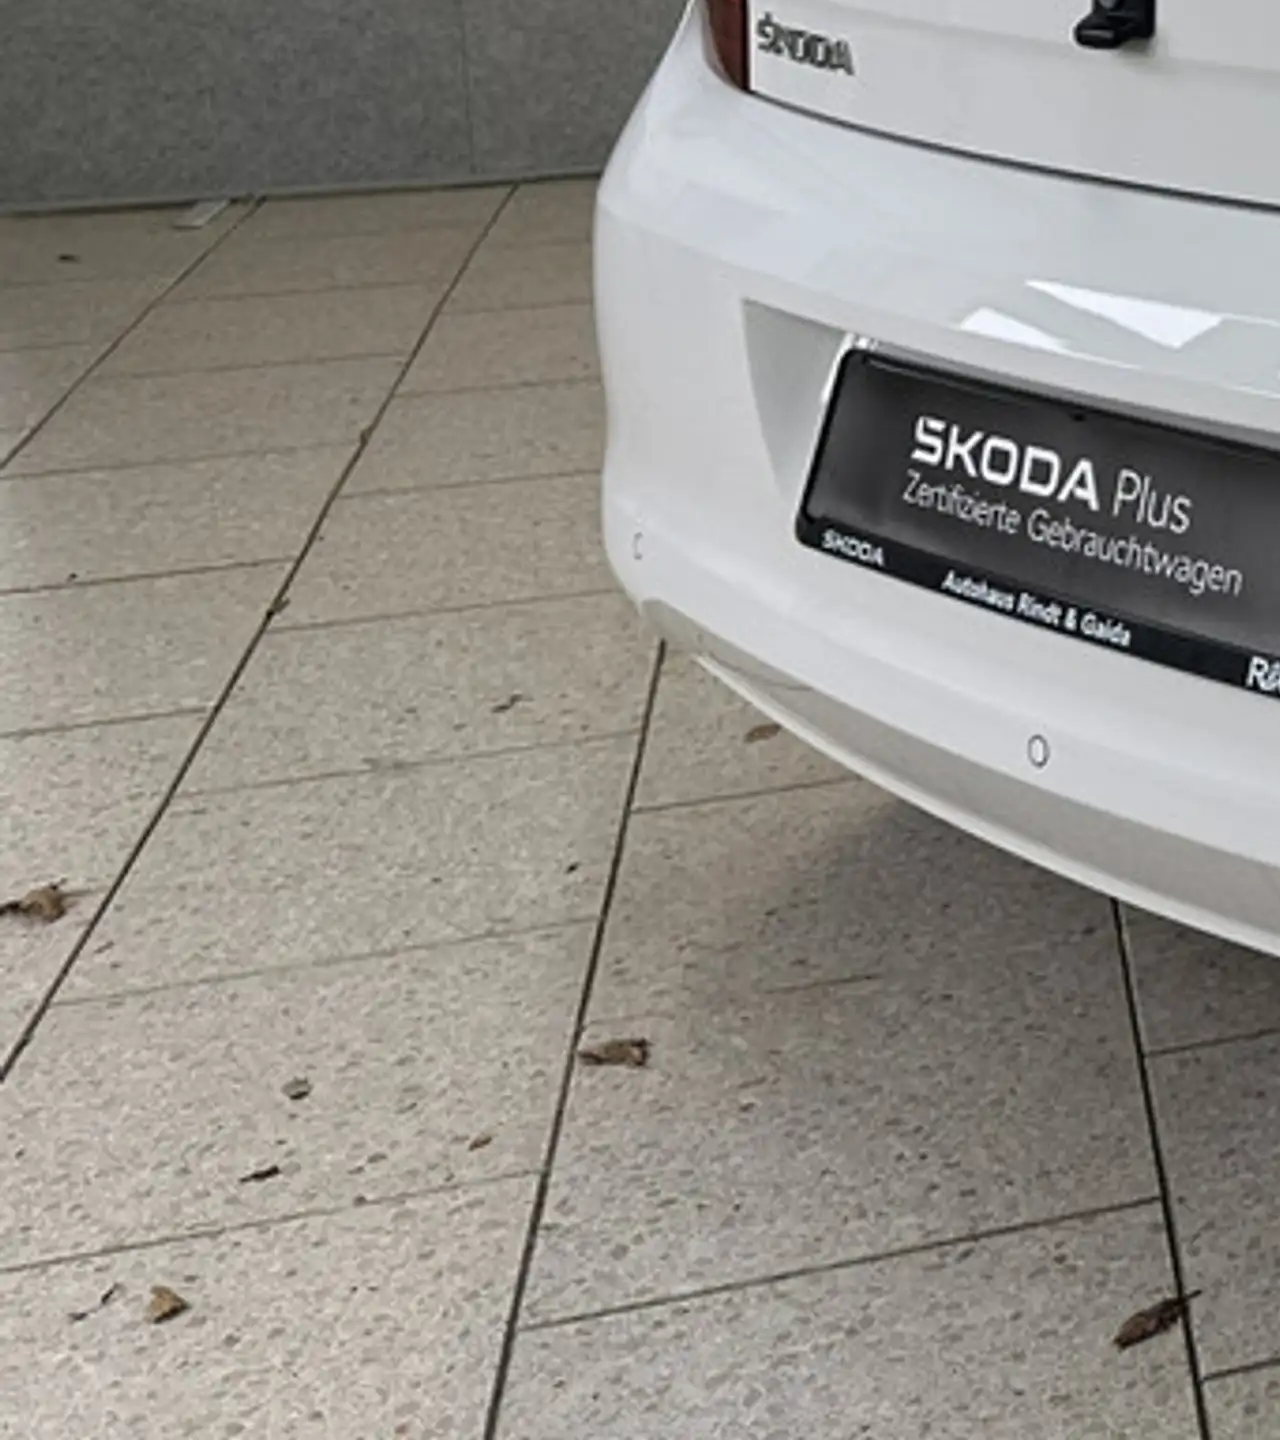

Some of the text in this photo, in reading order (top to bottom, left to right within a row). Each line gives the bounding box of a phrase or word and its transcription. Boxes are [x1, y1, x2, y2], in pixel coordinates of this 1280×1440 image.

[902, 468, 1244, 596] Zertifizierte Gebrauchtwagen
[1112, 468, 1194, 535] Plus
[940, 568, 1016, 612] Autohaus
[1064, 607, 1078, 632] &
